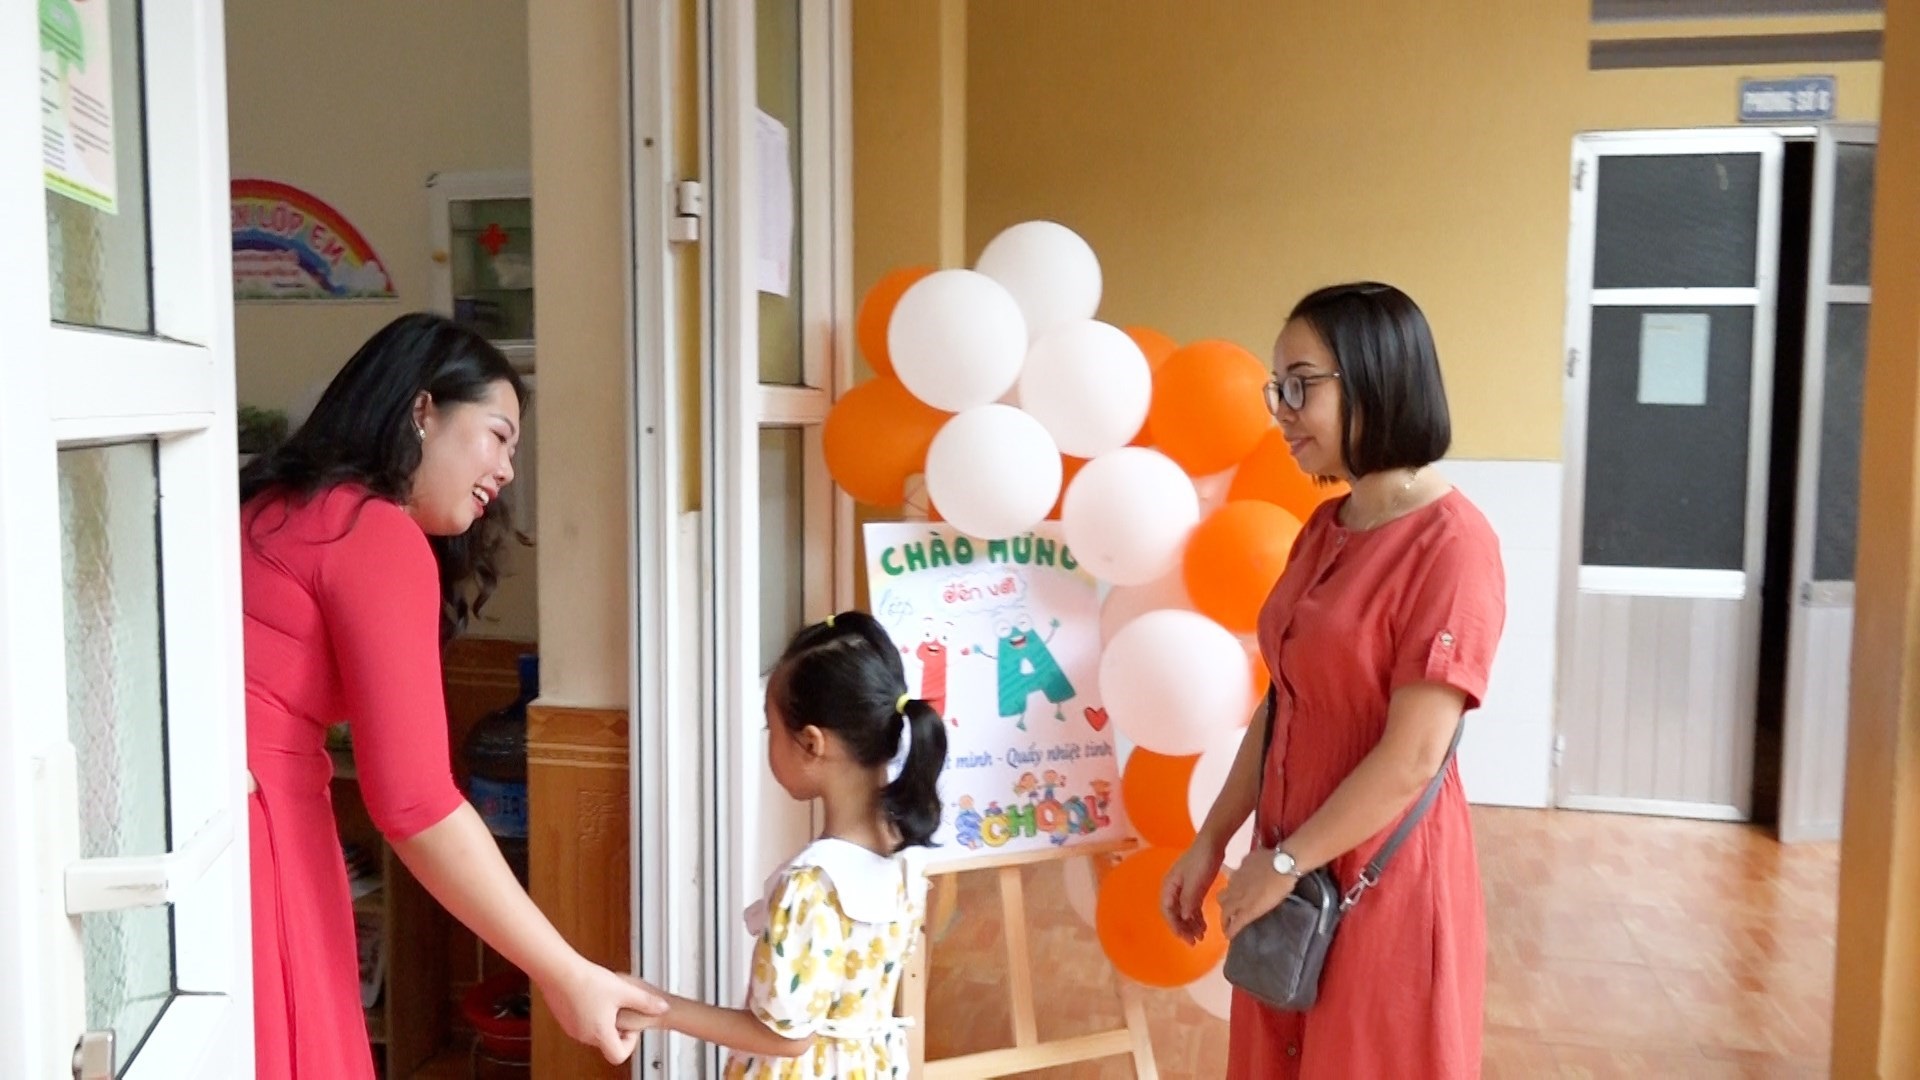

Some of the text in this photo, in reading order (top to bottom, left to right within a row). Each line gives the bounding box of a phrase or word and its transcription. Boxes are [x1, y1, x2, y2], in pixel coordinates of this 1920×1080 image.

[311, 224, 345, 265] EM
[880, 531, 973, 576] CHÀO
[955, 796, 1111, 848] SCHOOL
